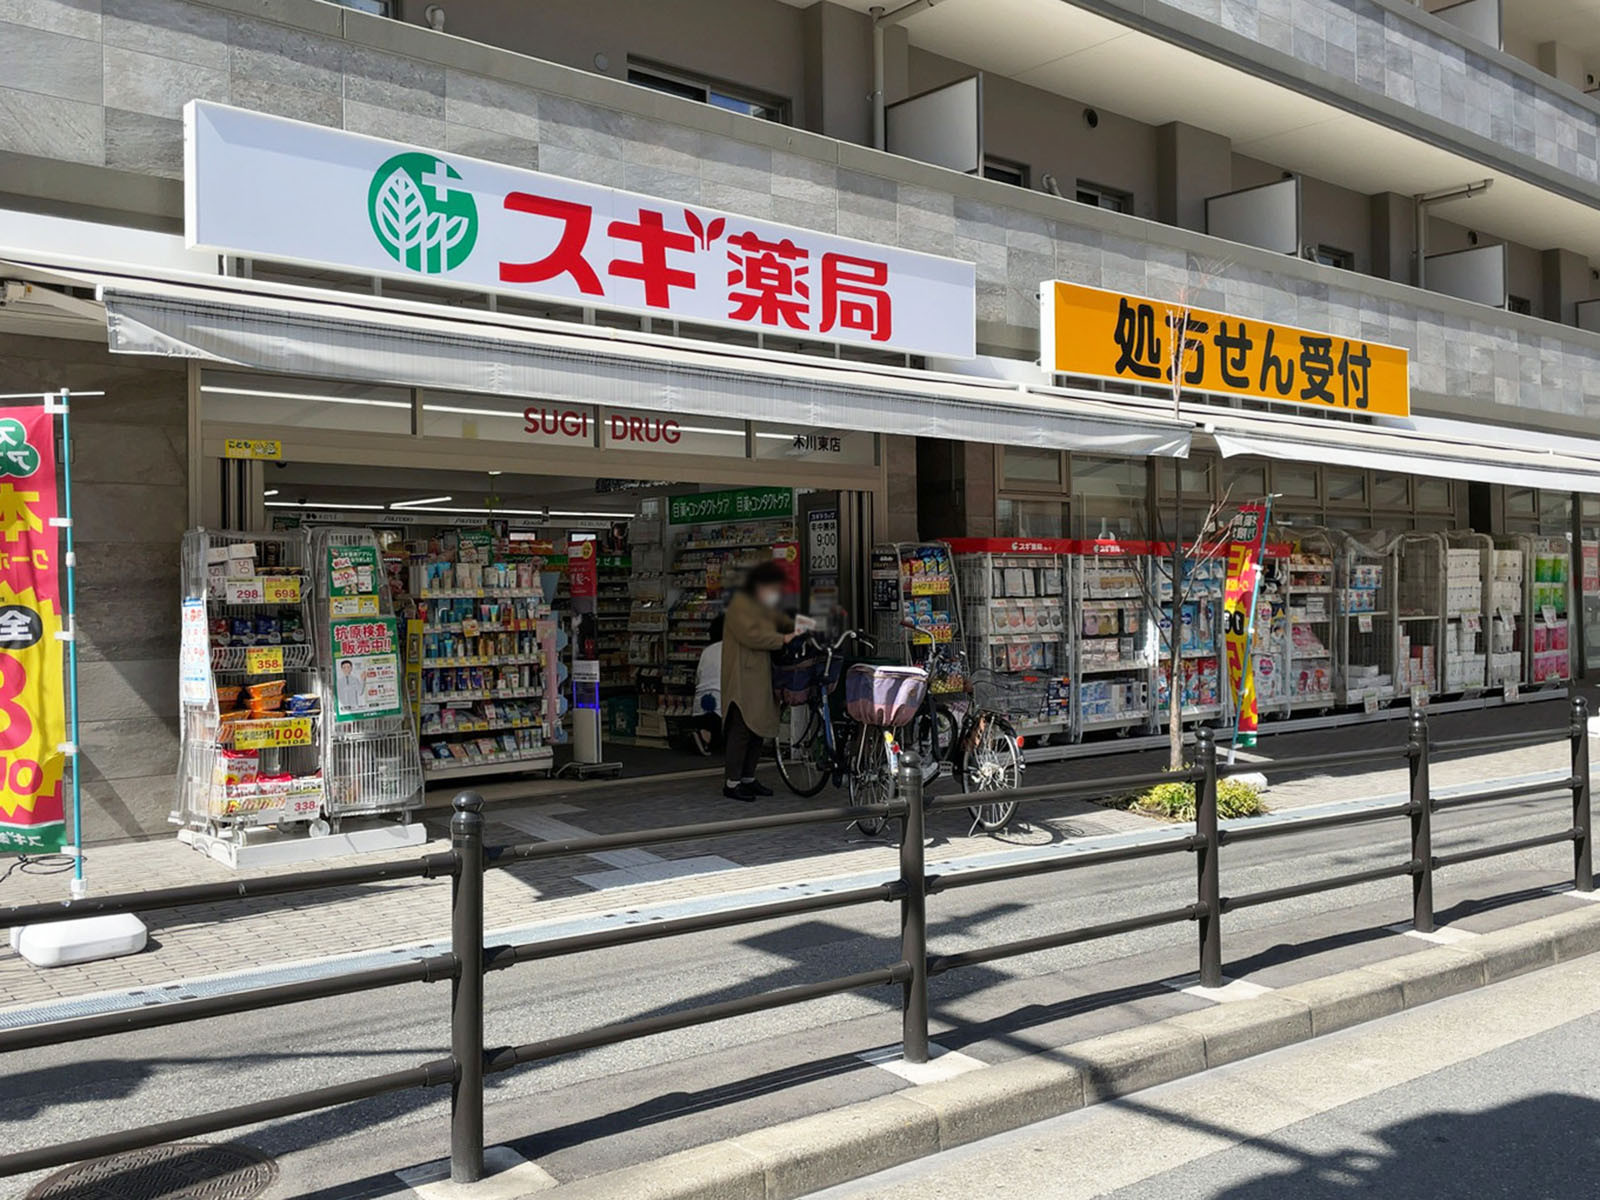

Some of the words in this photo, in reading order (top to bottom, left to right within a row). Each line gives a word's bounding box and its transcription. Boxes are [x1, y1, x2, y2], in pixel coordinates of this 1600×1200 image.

[499, 191, 892, 342] スギ薬局
[1114, 298, 1371, 409] 処方せん受付
[524, 407, 587, 438] SUGI
[611, 414, 681, 444] DRUG
[793, 434, 841, 452] 木川東店
[817, 533, 836, 546] 9:00
[812, 555, 836, 569] 22:00
[237, 589, 258, 599] 298
[275, 589, 296, 598] 698
[257, 660, 279, 669] 358
[275, 728, 304, 741] 100
[295, 801, 316, 812] 338
